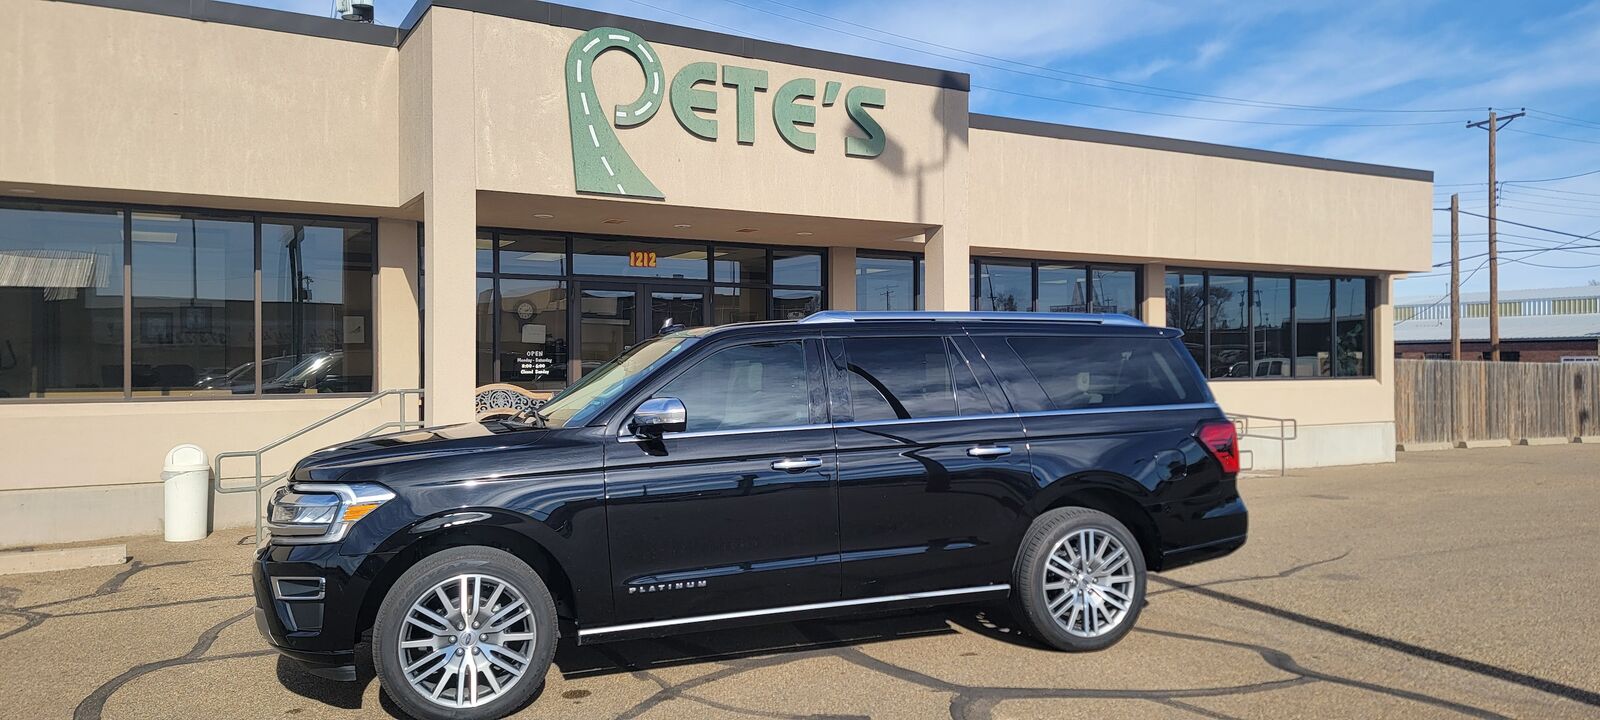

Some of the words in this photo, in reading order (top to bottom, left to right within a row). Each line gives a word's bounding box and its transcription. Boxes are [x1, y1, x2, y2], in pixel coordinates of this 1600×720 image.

[565, 27, 887, 201] PETE'S
[630, 251, 656, 267] 1212
[628, 580, 707, 594] PLATINUM
